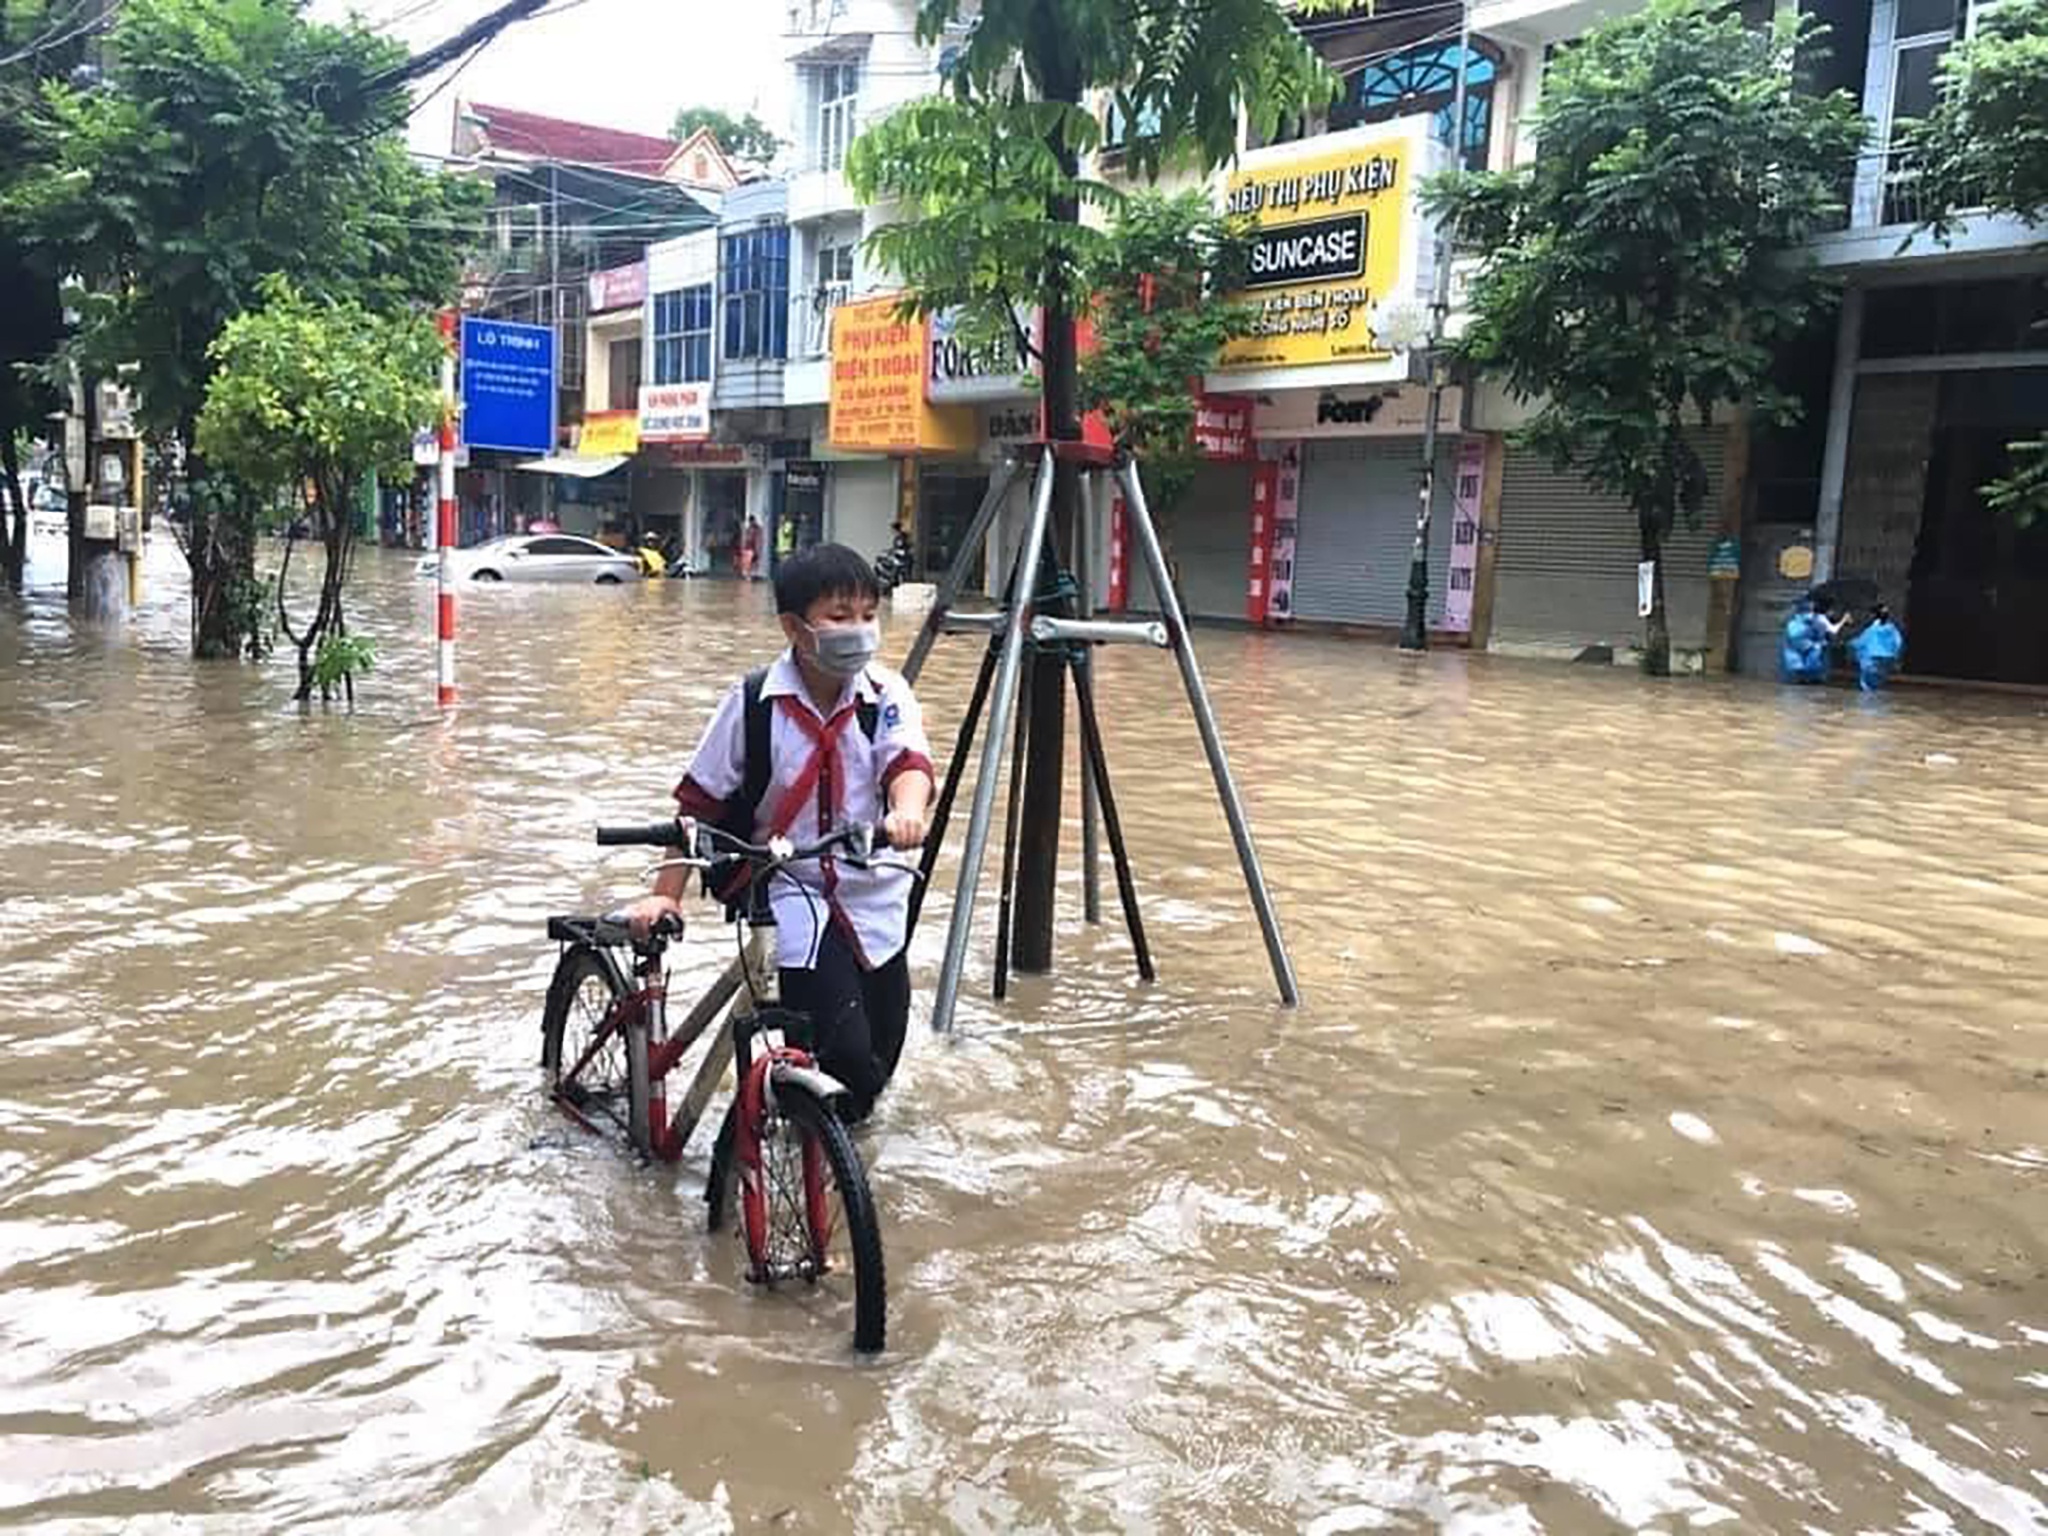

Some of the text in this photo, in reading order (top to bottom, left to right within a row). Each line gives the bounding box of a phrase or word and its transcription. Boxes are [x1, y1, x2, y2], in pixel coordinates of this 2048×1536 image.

[1267, 178, 1300, 212] THỊ
[1302, 169, 1343, 204] PHỤ
[1346, 154, 1397, 197] KIỆN
[1251, 230, 1356, 273] SUNCASE
[842, 329, 871, 353] PHỤ
[836, 354, 919, 381] ĐIỆN THOẠI
